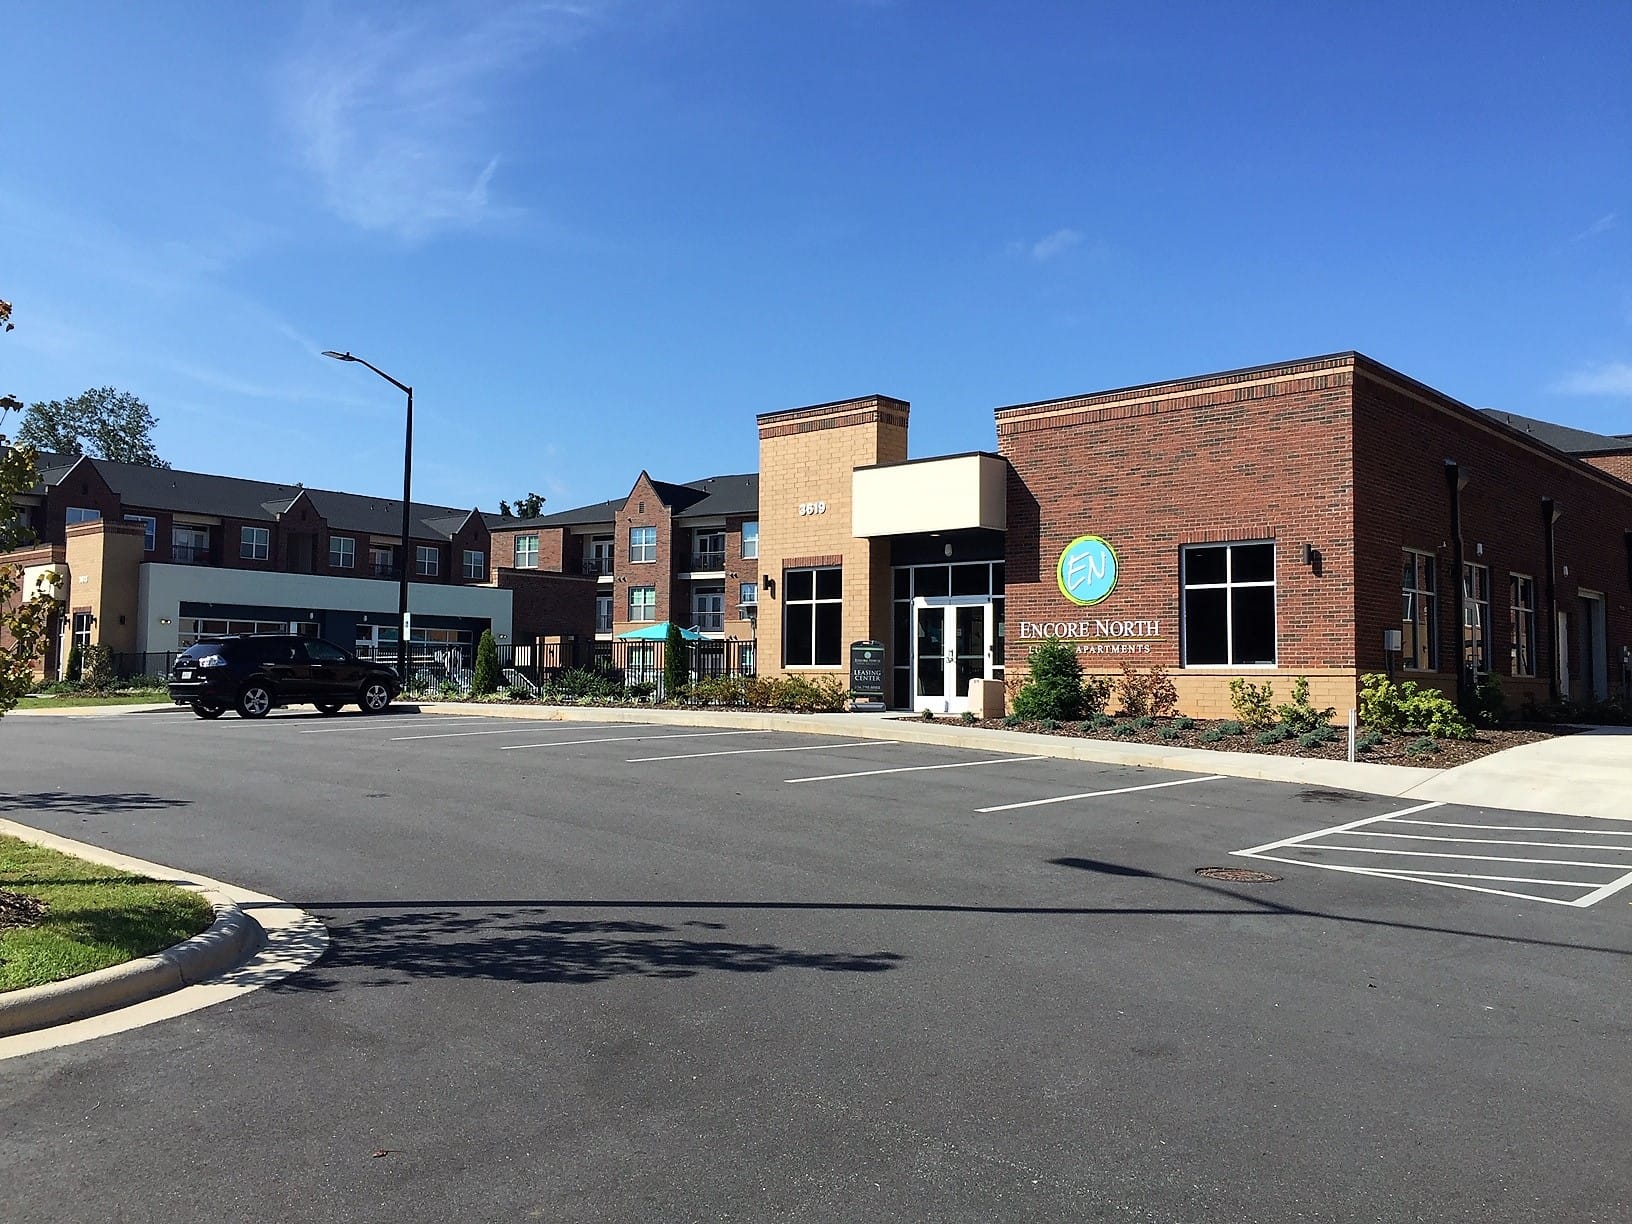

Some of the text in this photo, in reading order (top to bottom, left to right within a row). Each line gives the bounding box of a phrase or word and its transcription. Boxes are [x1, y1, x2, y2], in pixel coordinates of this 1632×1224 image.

[1067, 551, 1107, 591] EN
[1019, 620, 1160, 639] ENCORE NORTH
[1075, 644, 1151, 654] APARTMENTS
